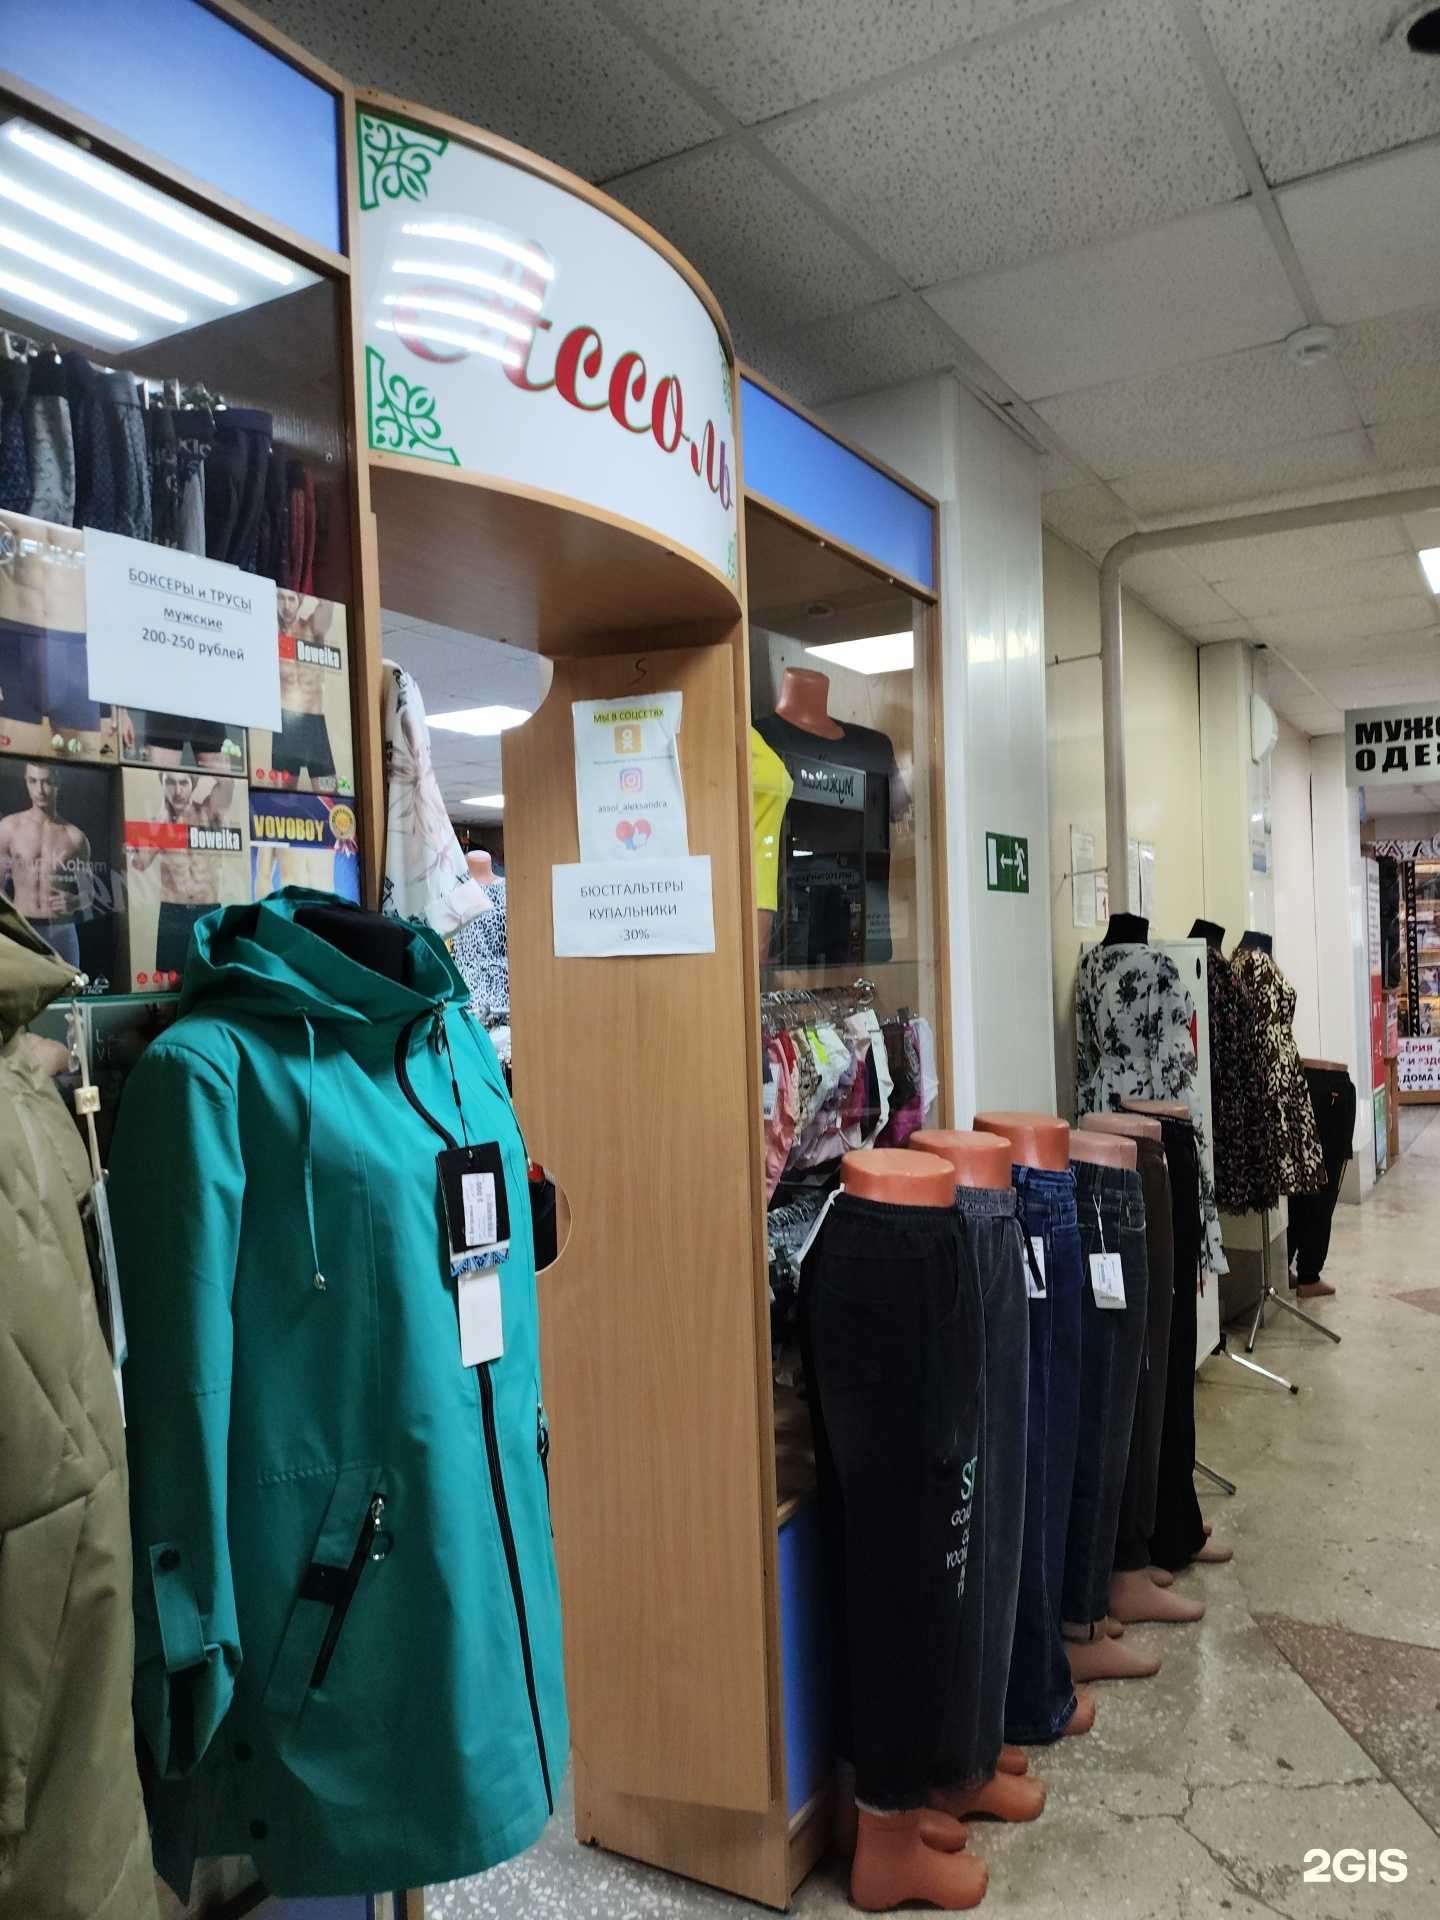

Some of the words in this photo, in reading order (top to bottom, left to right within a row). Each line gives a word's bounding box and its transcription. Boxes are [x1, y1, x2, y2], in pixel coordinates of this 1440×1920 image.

[128, 567, 194, 596] БОКСЕРЫ
[198, 589, 207, 598] и
[209, 589, 251, 610] ТРУСЫ
[163, 606, 223, 629] мужские
[142, 627, 195, 650] 200-250
[198, 640, 245, 660] рублей
[1355, 716, 1440, 745] МУЖ
[1355, 743, 1440, 773] ОДЕ
[253, 815, 325, 842] VOVOBOY
[580, 879, 684, 898] БЮСТГАЛЬТЕРЫ
[589, 904, 677, 920] КУПАЛЬНИКИ
